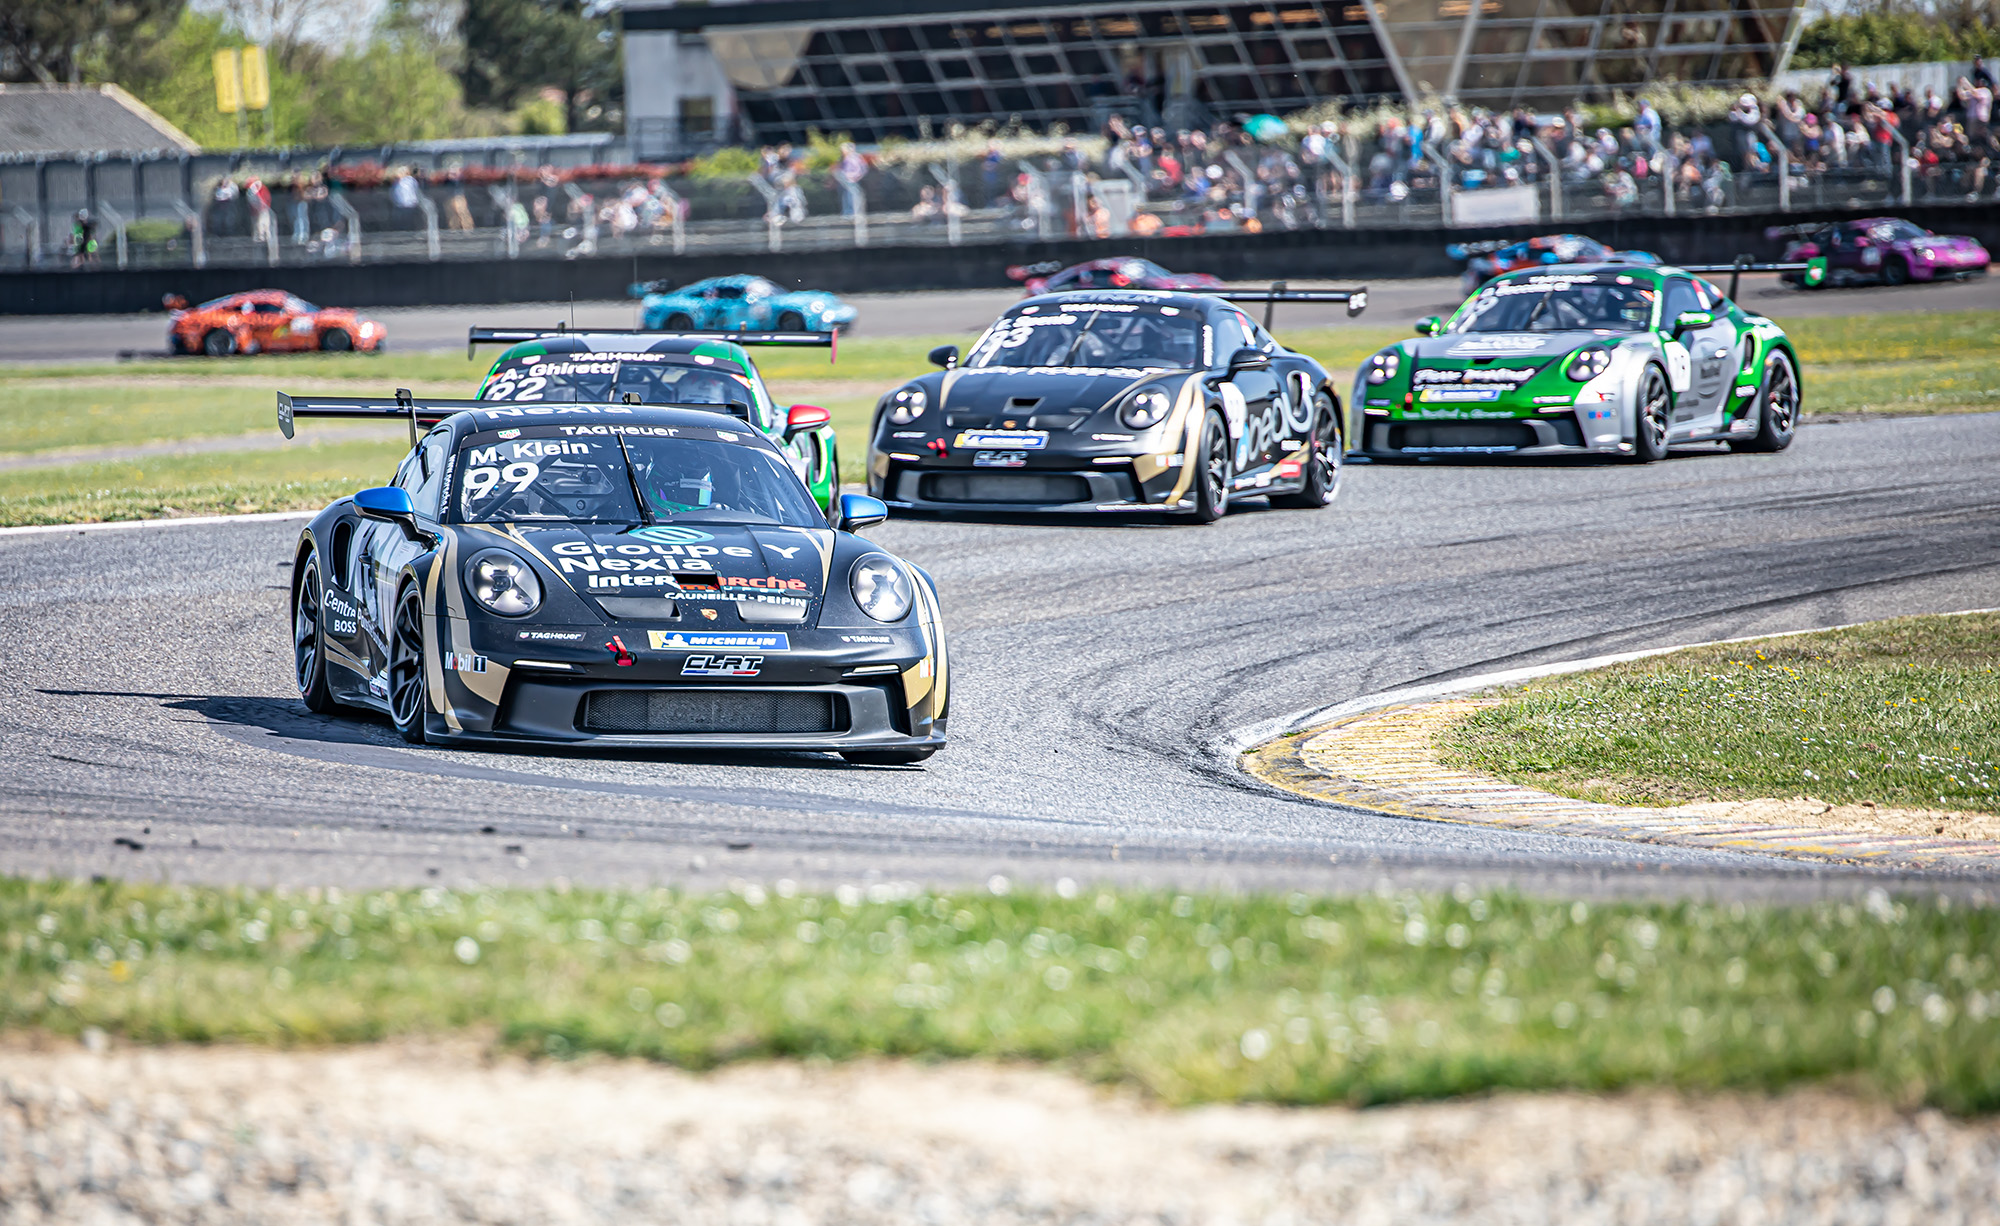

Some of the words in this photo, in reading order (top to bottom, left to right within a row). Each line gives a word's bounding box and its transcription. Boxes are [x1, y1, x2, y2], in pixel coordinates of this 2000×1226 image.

[529, 362, 617, 377] Ghiretti
[470, 446, 506, 466] M.
[513, 440, 589, 459] Klein
[463, 462, 540, 501] 99
[551, 541, 753, 558] Groupe
[762, 543, 800, 559] Y
[558, 555, 713, 573] Nexia
[664, 592, 747, 601] CAUNEILLE
[757, 595, 807, 607] PEIPIN
[334, 619, 357, 634] BOSS
[689, 637, 777, 646] MICHELIN
[444, 651, 471, 672] Mobil
[683, 656, 764, 670] CLRT
